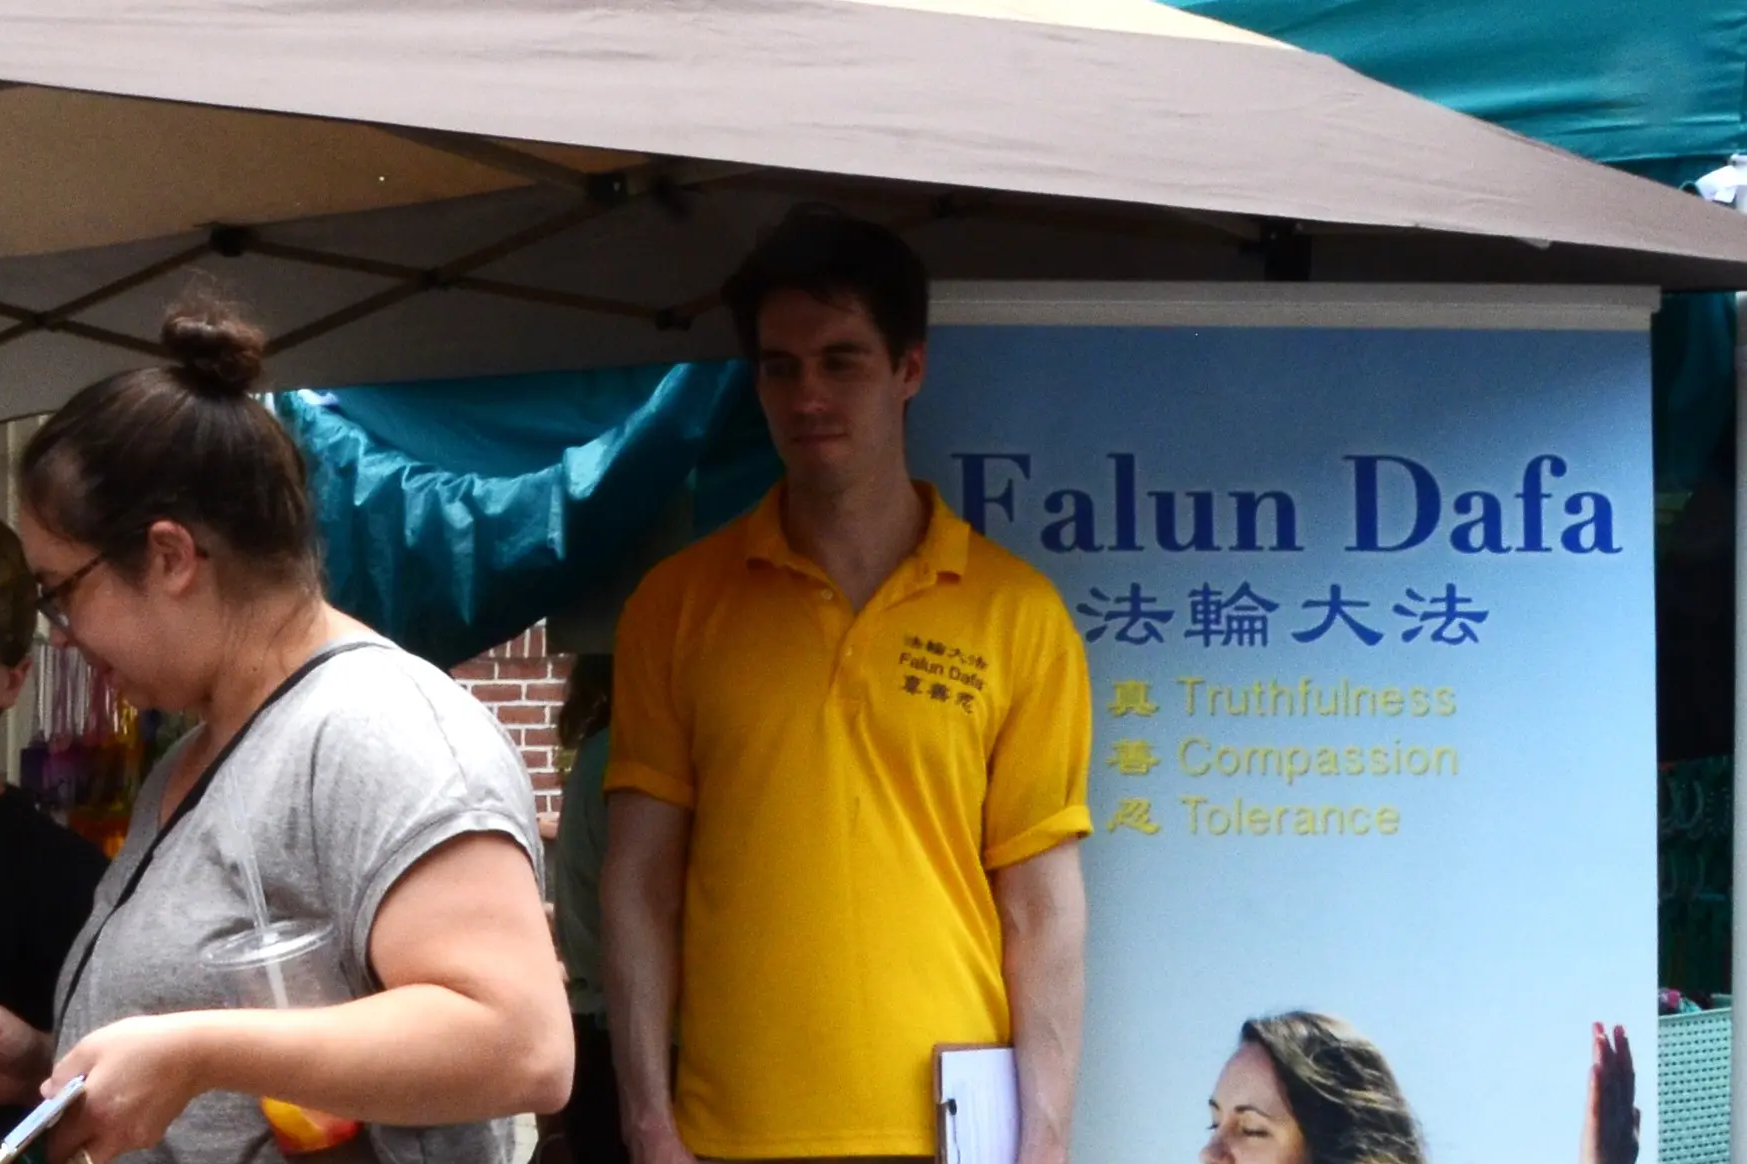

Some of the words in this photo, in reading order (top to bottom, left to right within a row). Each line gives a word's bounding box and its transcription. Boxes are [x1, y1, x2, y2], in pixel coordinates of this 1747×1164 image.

[950, 452, 1305, 553] Falun
[1343, 453, 1624, 554] Dafa
[1075, 581, 1490, 647] 法輪大法
[898, 652, 944, 675] Falun
[949, 665, 984, 692] Dafa
[1176, 677, 1456, 717] Truthfulness
[1178, 739, 1459, 783] Compassion
[1179, 798, 1401, 835] Tolerance
